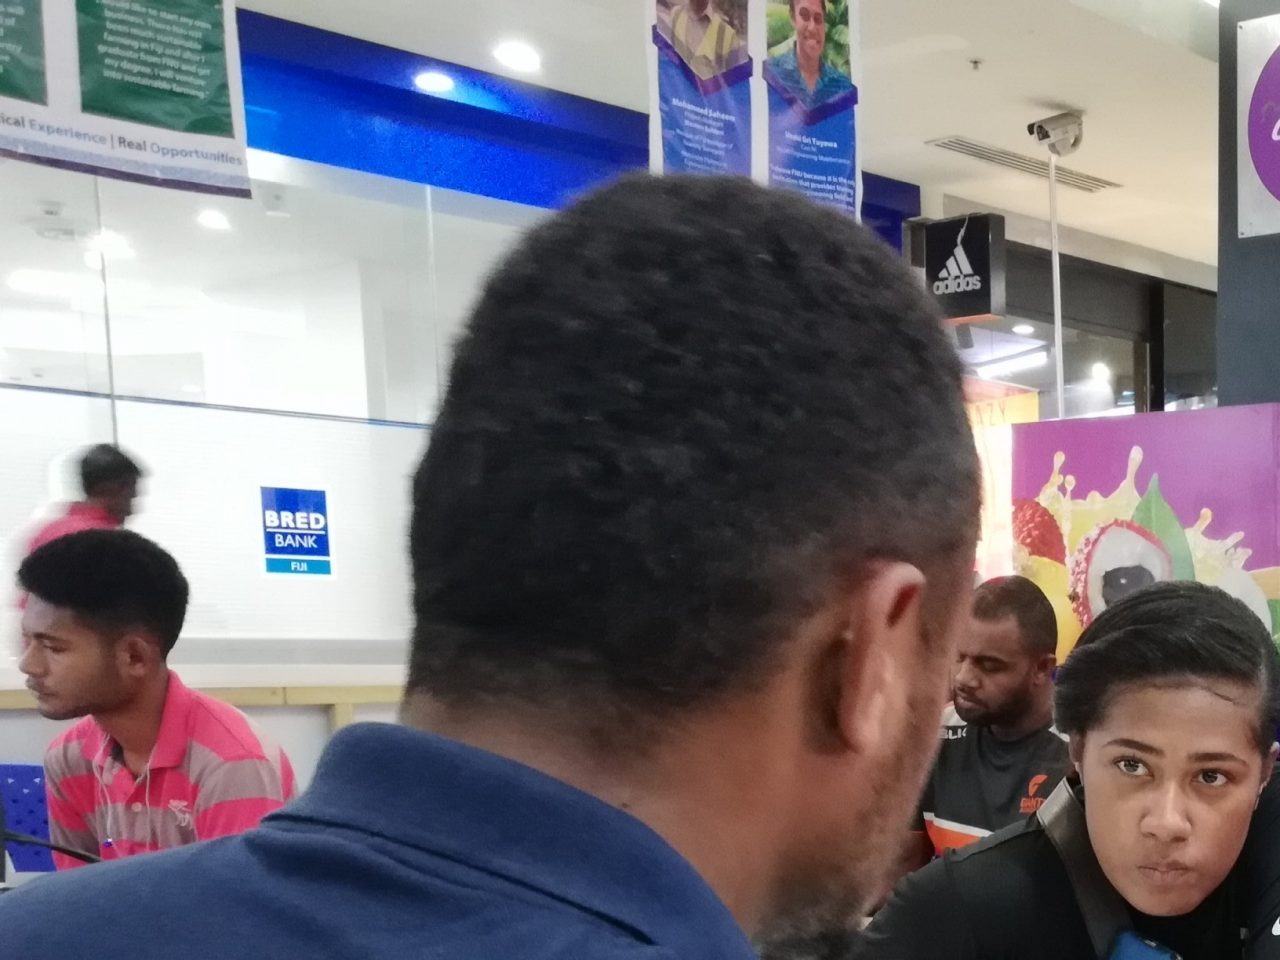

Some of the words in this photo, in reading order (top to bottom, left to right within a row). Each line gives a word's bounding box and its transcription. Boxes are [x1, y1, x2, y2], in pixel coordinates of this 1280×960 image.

[29, 119, 107, 145] Experience
[118, 136, 148, 152] Real
[150, 142, 243, 167] Opportunities
[933, 275, 982, 295] adidas
[264, 510, 326, 529] BRED
[275, 533, 318, 548] BANK
[290, 561, 308, 571] FIJI
